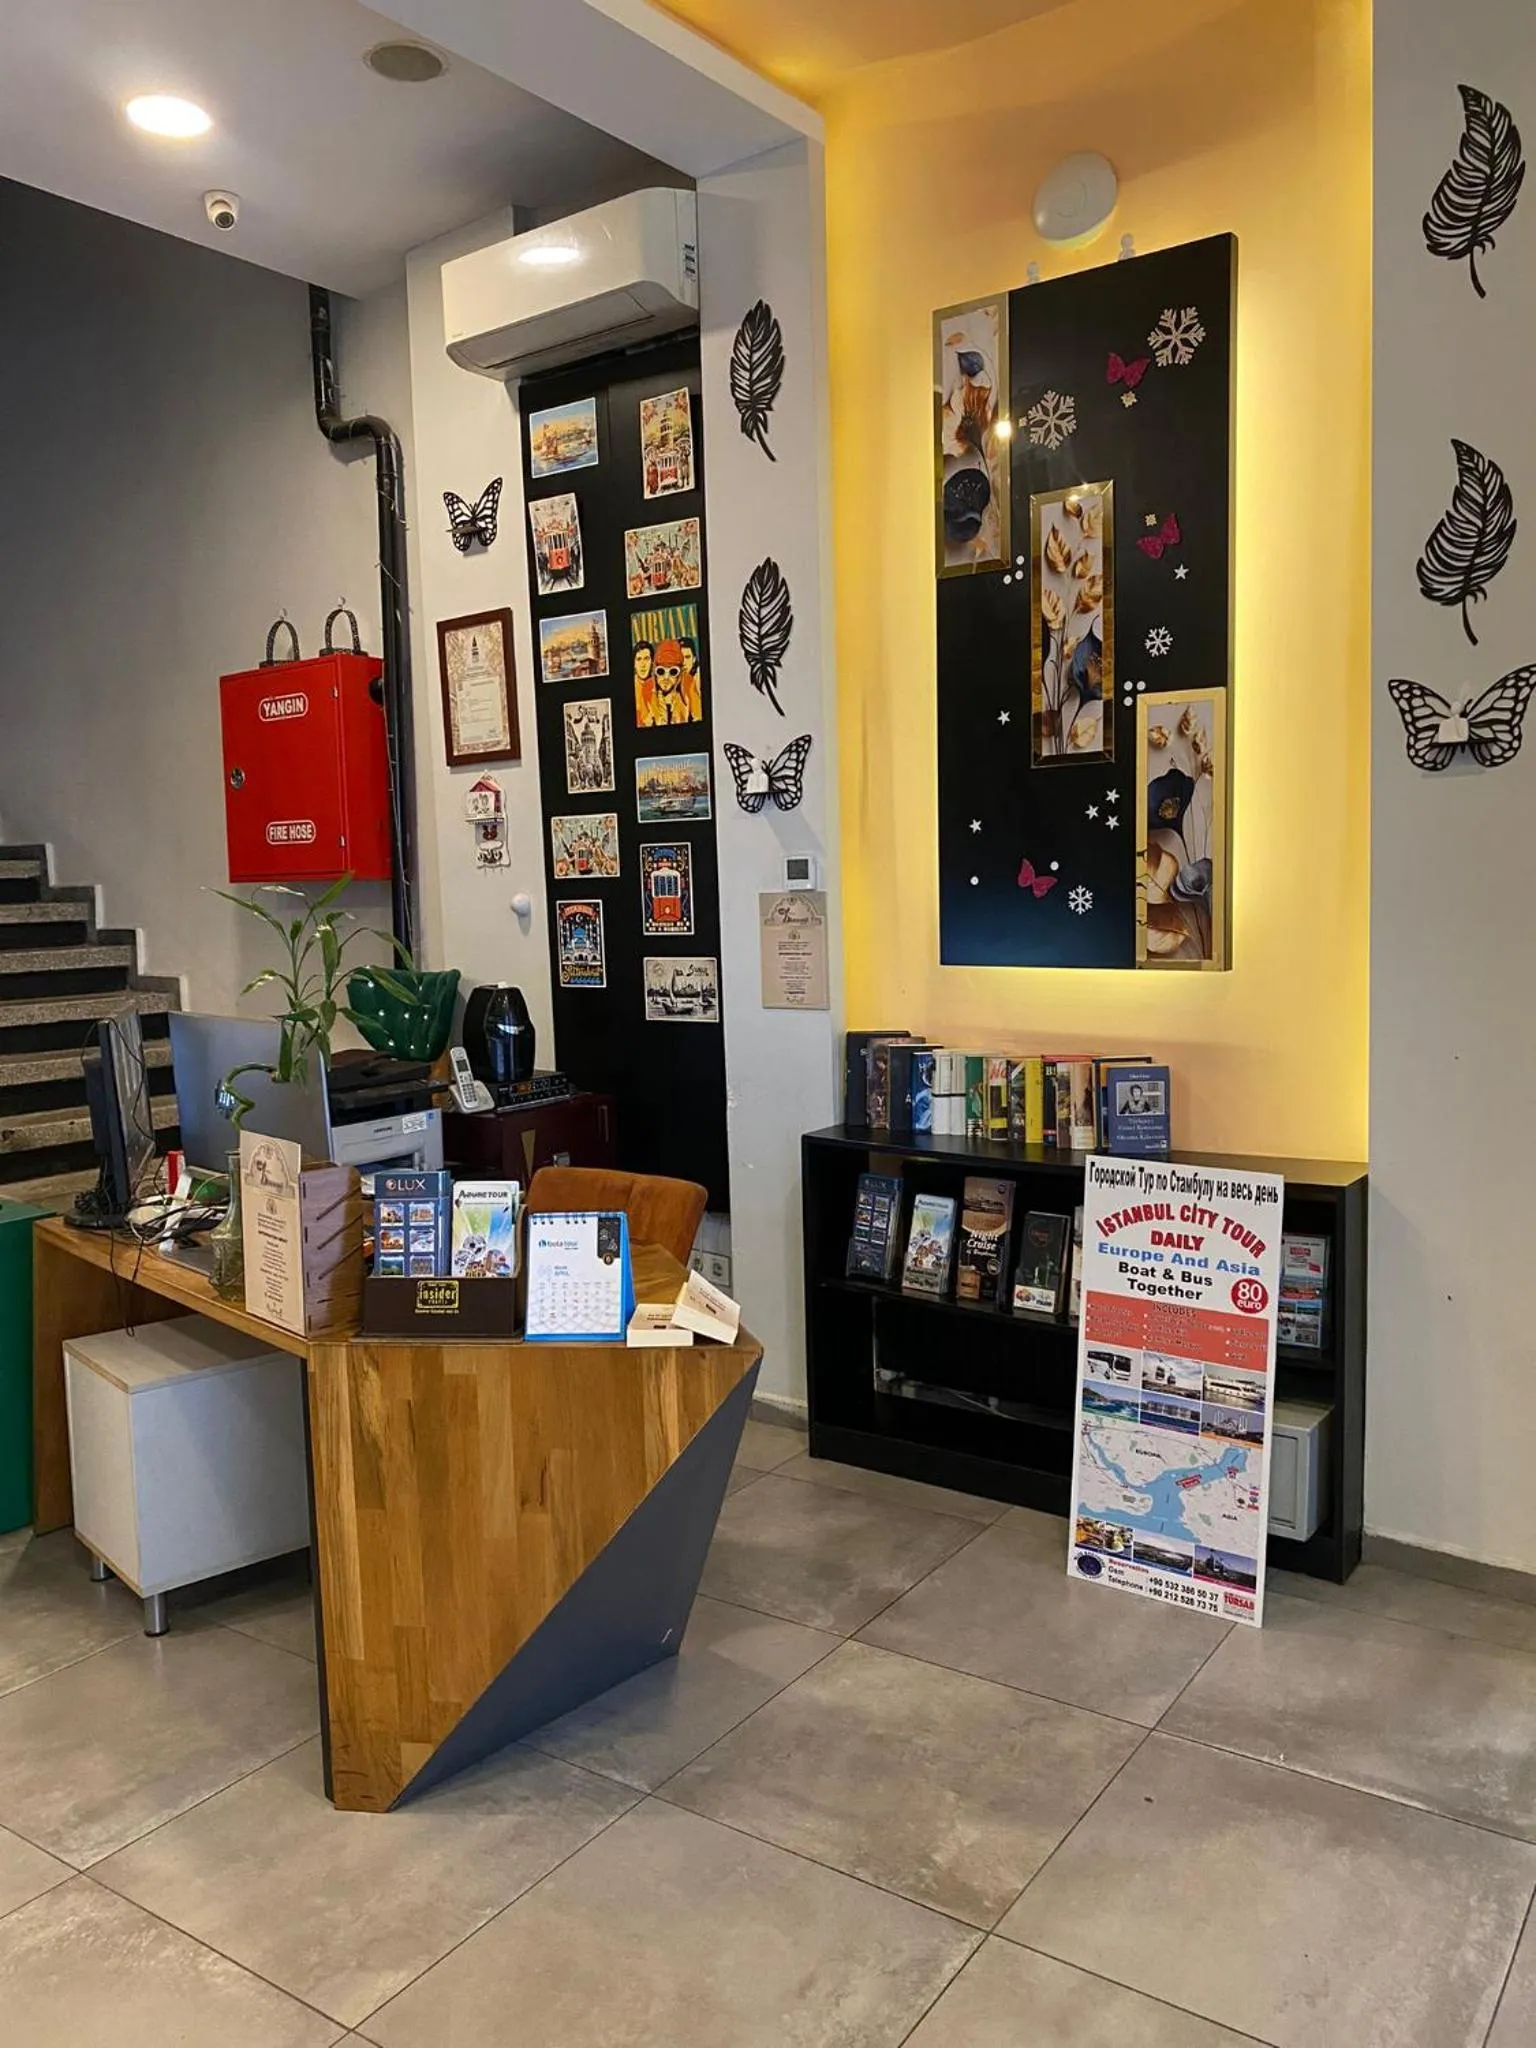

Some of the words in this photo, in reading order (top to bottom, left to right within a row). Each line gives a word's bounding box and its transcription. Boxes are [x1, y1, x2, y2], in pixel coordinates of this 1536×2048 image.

[262, 698, 304, 717] YANGIN
[269, 825, 288, 840] FIRE
[289, 823, 312, 839] HOSE
[1089, 1161, 1137, 1190] Городской
[1138, 1167, 1155, 1194] Тур
[1156, 1175, 1168, 1190] по
[1169, 1170, 1214, 1201] Стамбулу
[1216, 1181, 1229, 1197] на
[1231, 1182, 1253, 1201] весь
[1254, 1186, 1279, 1205] день
[966, 1238, 997, 1251] Cruise
[1151, 1230, 1205, 1252] DAILY
[1222, 1217, 1267, 1259] TOUR
[1098, 1241, 1165, 1264] Europe
[1171, 1252, 1209, 1269] And
[1216, 1259, 1261, 1276] Asia
[1118, 1261, 1156, 1279] Boat
[1162, 1268, 1175, 1280] &
[1181, 1270, 1213, 1287] Bus
[419, 1288, 456, 1300] insider
[1127, 1277, 1203, 1301] Together
[1236, 1282, 1262, 1301] 80
[1152, 1303, 1198, 1319] INCLUDES
[1236, 1299, 1262, 1311] euro
[1108, 1574, 1144, 1593] Telephone
[1164, 1590, 1179, 1602] 212
[1196, 1599, 1207, 1610] 73
[1149, 1577, 1163, 1587] +90
[1164, 1580, 1179, 1591] 532
[1208, 1591, 1219, 1602] 37
